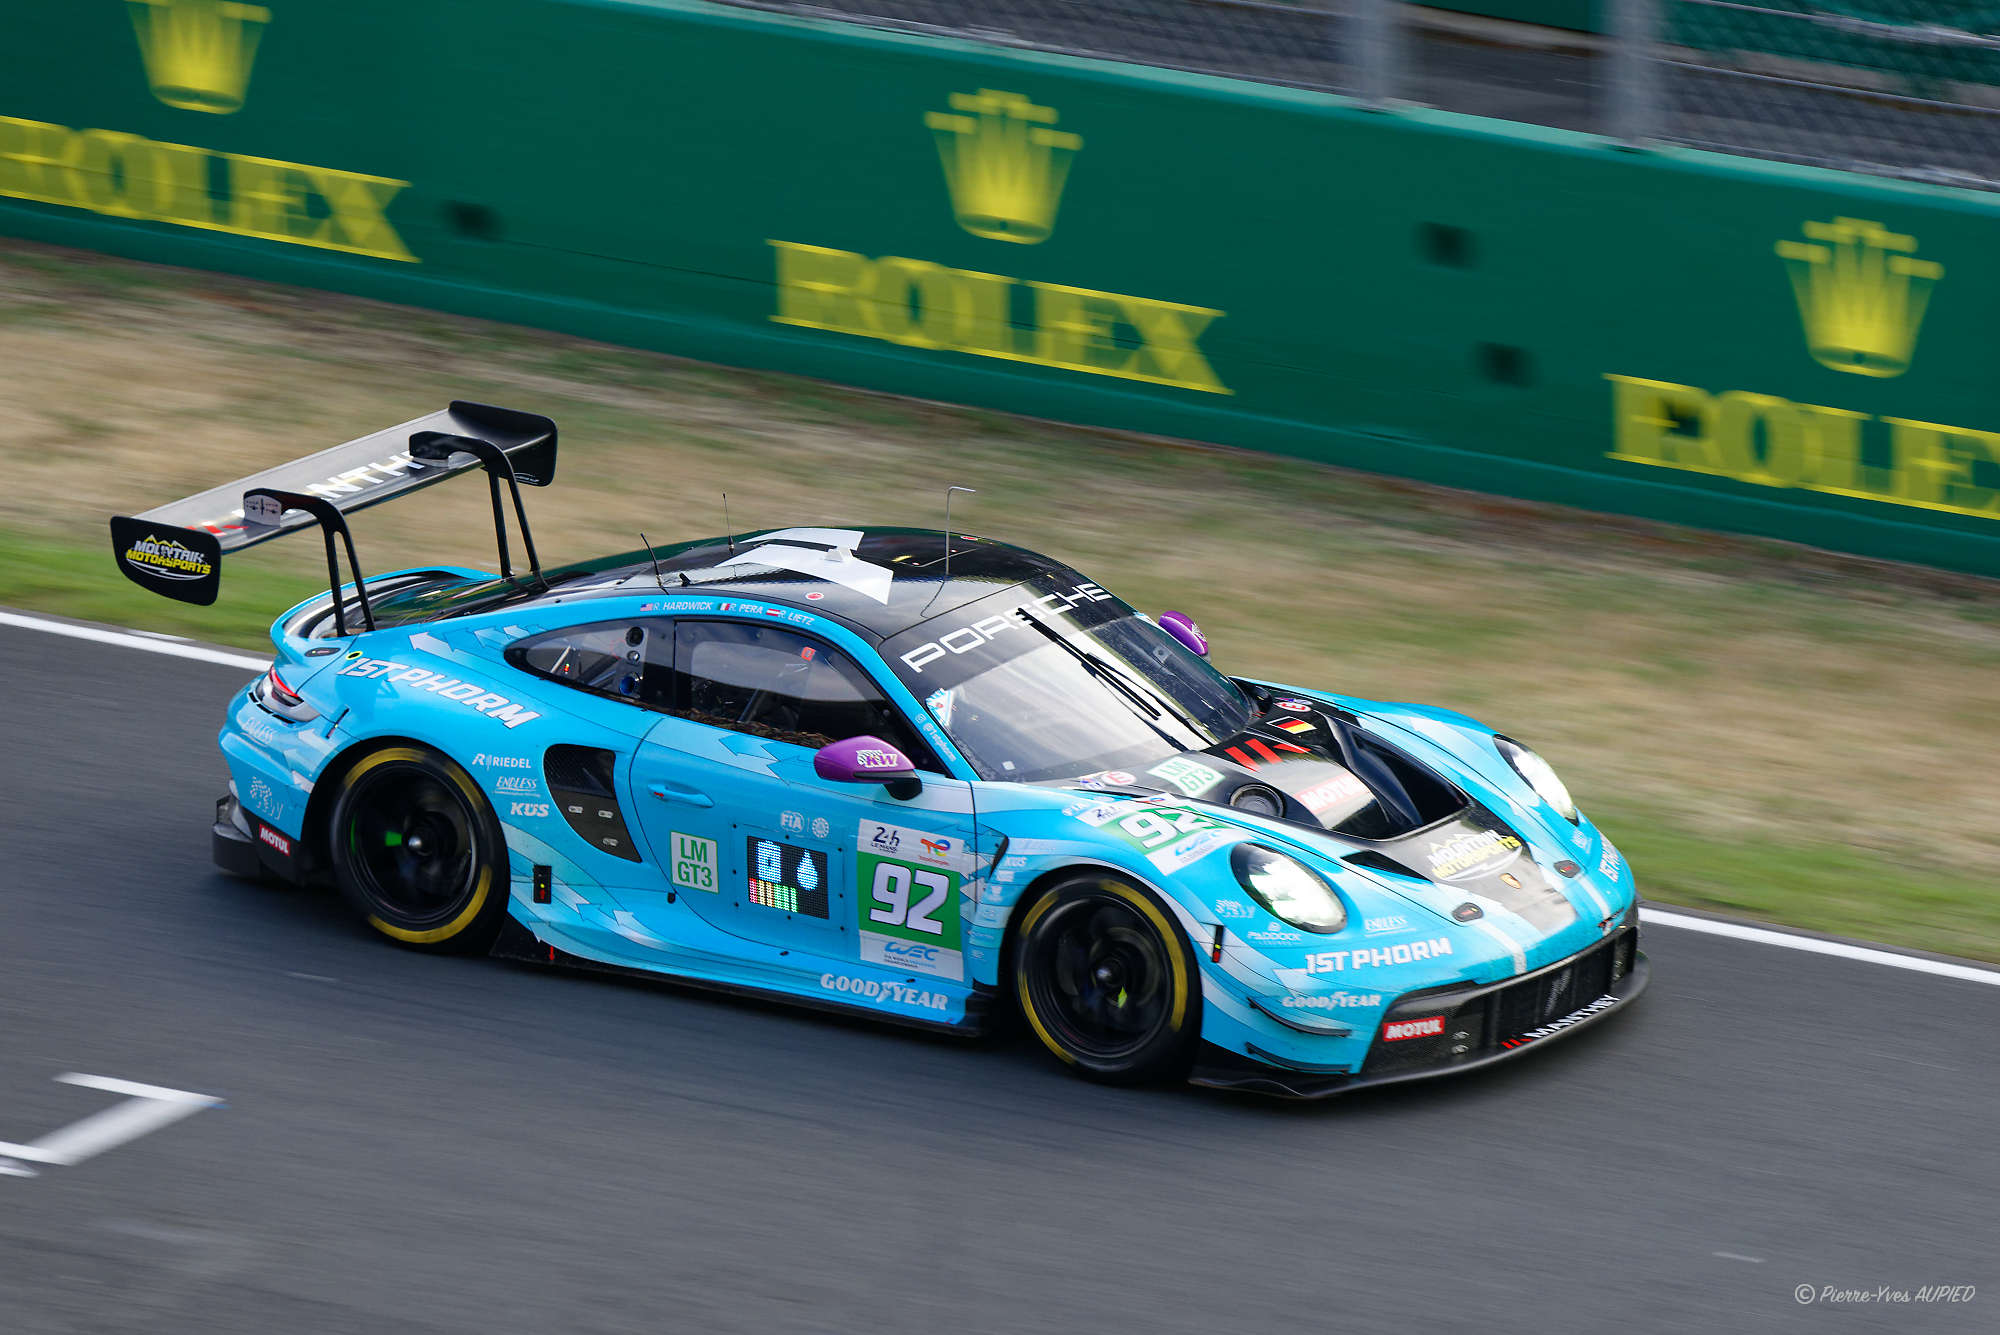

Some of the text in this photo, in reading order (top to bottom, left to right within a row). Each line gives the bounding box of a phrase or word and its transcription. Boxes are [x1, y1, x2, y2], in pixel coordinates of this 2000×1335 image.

[766, 238, 1236, 396] ROLEX
[1602, 373, 2000, 521] ROLE
[126, 548, 212, 575] MOTORSPORTS
[662, 601, 713, 611] HARDWICK
[738, 603, 764, 614] PERA
[787, 612, 816, 626] LIETZ
[899, 582, 1113, 673] PORSCHE
[338, 656, 543, 730] 1ST PHORM
[493, 756, 532, 769] RIEDEL
[496, 776, 537, 789] ENDLESS
[1179, 768, 1216, 792] GT3
[510, 801, 550, 818] KÜS
[781, 811, 803, 831] FIA
[260, 827, 289, 854] MOTUL
[1118, 808, 1219, 849] 92
[679, 836, 708, 864] LM
[677, 862, 713, 888] GT3
[868, 861, 951, 936] 92
[1305, 937, 1454, 975] 1ST PHORM
[820, 973, 949, 1011] GOODYEAR
[1281, 991, 1382, 1011] GOODYEAR
[1386, 1019, 1442, 1041] MOTUL
[1522, 994, 1621, 1039] MANTHEY
